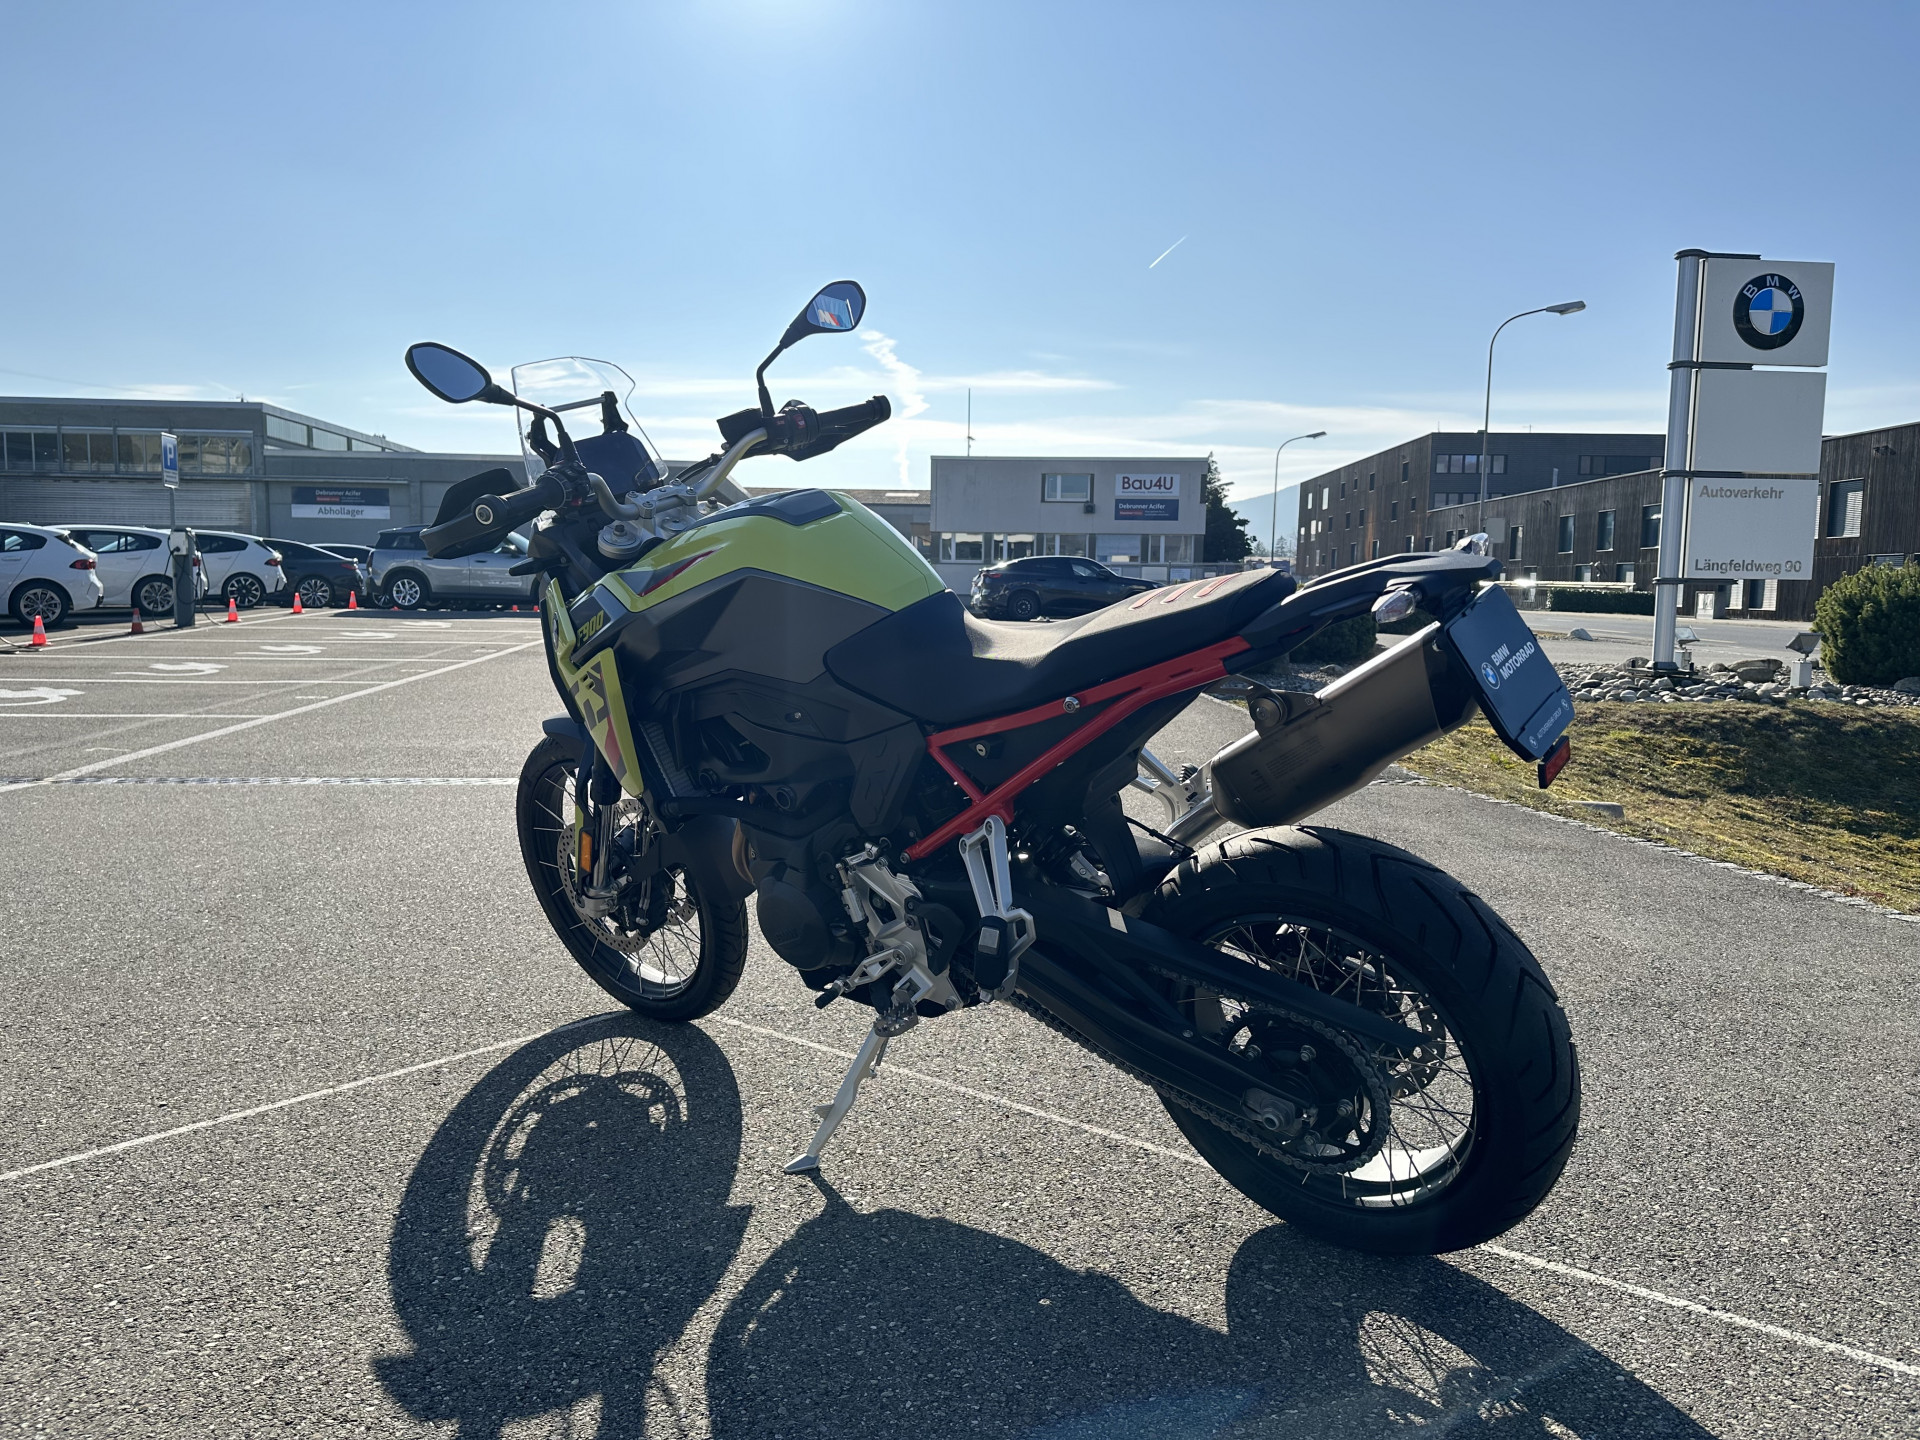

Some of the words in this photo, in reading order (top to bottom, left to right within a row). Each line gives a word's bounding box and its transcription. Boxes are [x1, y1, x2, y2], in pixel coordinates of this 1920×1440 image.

[1743, 275, 1801, 300] BMW
[167, 443, 174, 466] P
[1122, 476, 1174, 491] Bau4U
[1700, 485, 1784, 499] Autoverkehr
[315, 489, 344, 497] Debrunner
[317, 506, 364, 518] Abhollager
[1695, 558, 1782, 575] Längfeldweg
[1491, 643, 1510, 667] BMW
[1500, 641, 1535, 680] MOTORRAD
